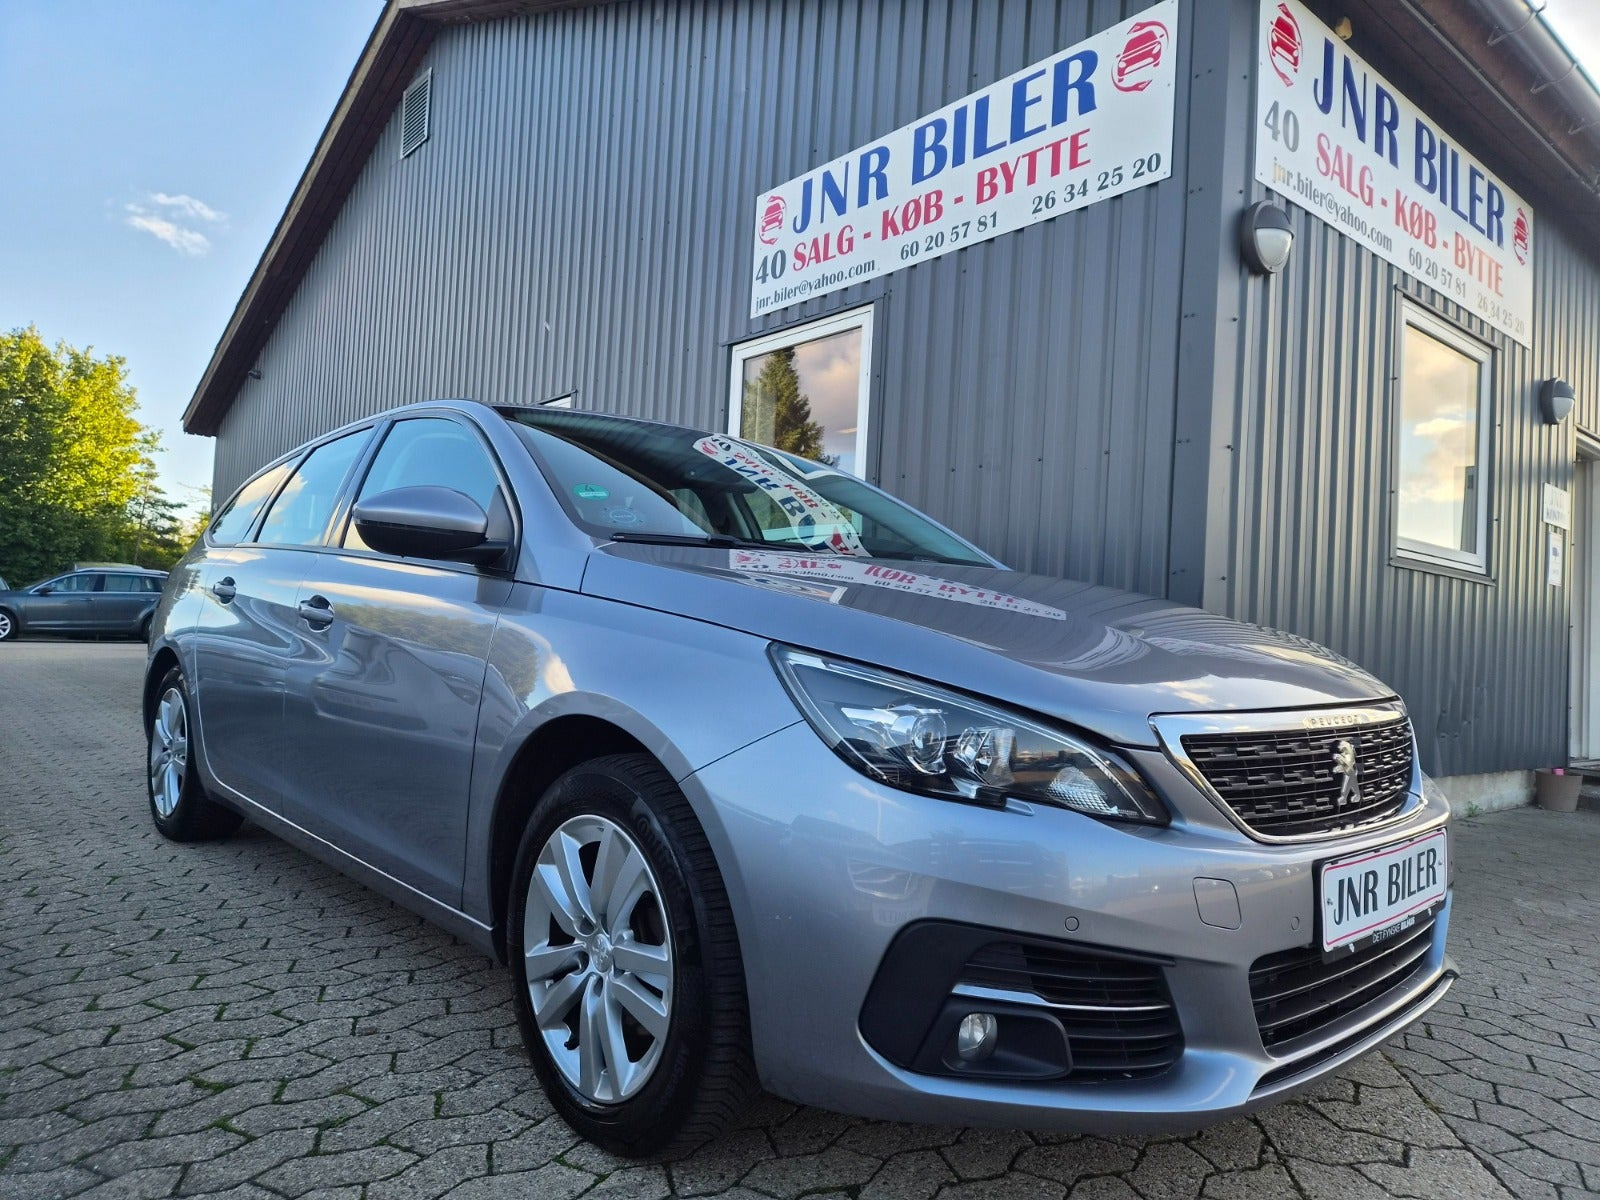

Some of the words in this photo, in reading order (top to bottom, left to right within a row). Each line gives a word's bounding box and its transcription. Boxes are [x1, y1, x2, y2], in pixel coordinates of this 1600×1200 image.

[793, 145, 891, 234] JNR
[911, 49, 1099, 186] BILER
[1264, 100, 1300, 153] 40
[1313, 36, 1399, 170] JNR
[1414, 116, 1505, 251] BILER
[792, 224, 855, 272] SALG
[881, 189, 944, 241] KØB
[976, 128, 1091, 206] BYTTE
[1031, 191, 1056, 215] 26
[1063, 178, 1089, 204] 34
[1096, 166, 1123, 192] 25
[1132, 152, 1162, 180] 20
[1272, 156, 1393, 253] jnr.biler@yahoo.com
[900, 240, 919, 260] 60
[925, 231, 945, 252] 20
[950, 221, 971, 243] 57
[977, 211, 998, 233] 81
[1316, 132, 1374, 209] SALG
[1395, 188, 1437, 250] KØB
[1454, 231, 1504, 298] BYTTE
[755, 249, 787, 285] 40
[755, 259, 876, 314] jnr.biler@yahoo.com
[1409, 247, 1422, 270] 60
[1425, 257, 1438, 280] 20
[1441, 267, 1453, 290] 57
[1456, 277, 1466, 299] 81
[1477, 292, 1488, 312] 26
[1490, 302, 1500, 322] 34
[1502, 309, 1513, 329] 25
[1515, 317, 1525, 337] 20
[1333, 869, 1378, 926] JNR
[1388, 847, 1438, 907] BILER
[1372, 931, 1384, 944] DET
